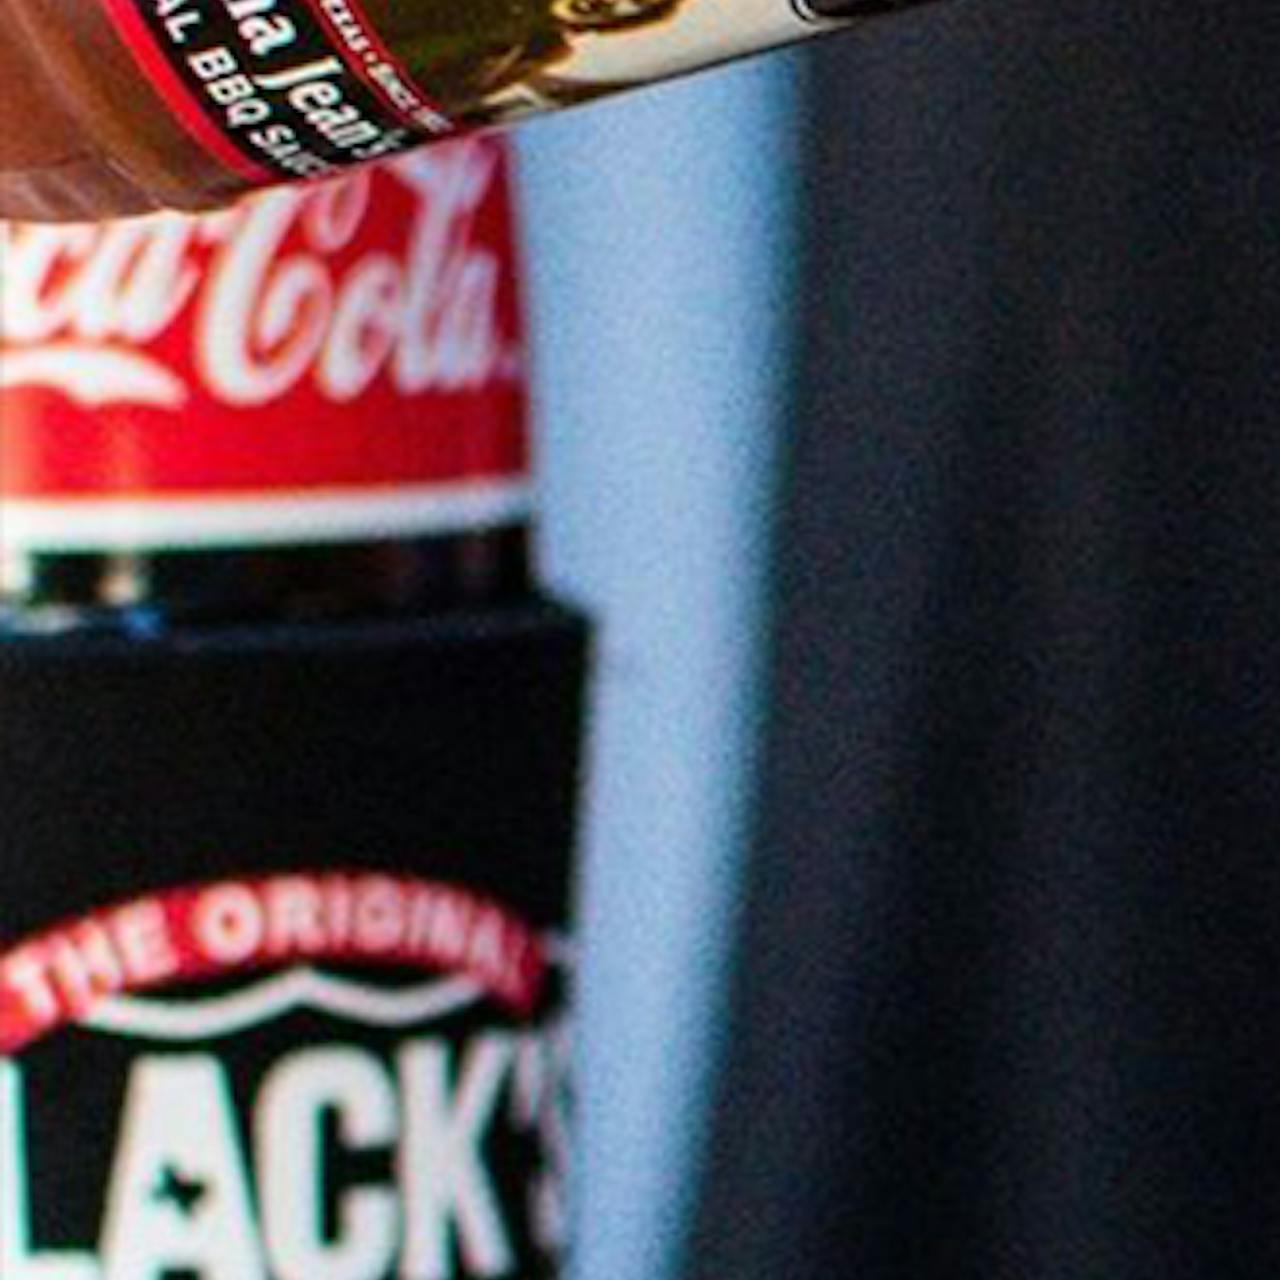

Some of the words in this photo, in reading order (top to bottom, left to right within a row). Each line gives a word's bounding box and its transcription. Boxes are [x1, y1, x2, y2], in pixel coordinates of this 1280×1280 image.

[186, 46, 271, 128] BBQ
[251, 54, 406, 160] Jean's
[8, 897, 180, 1022] THE
